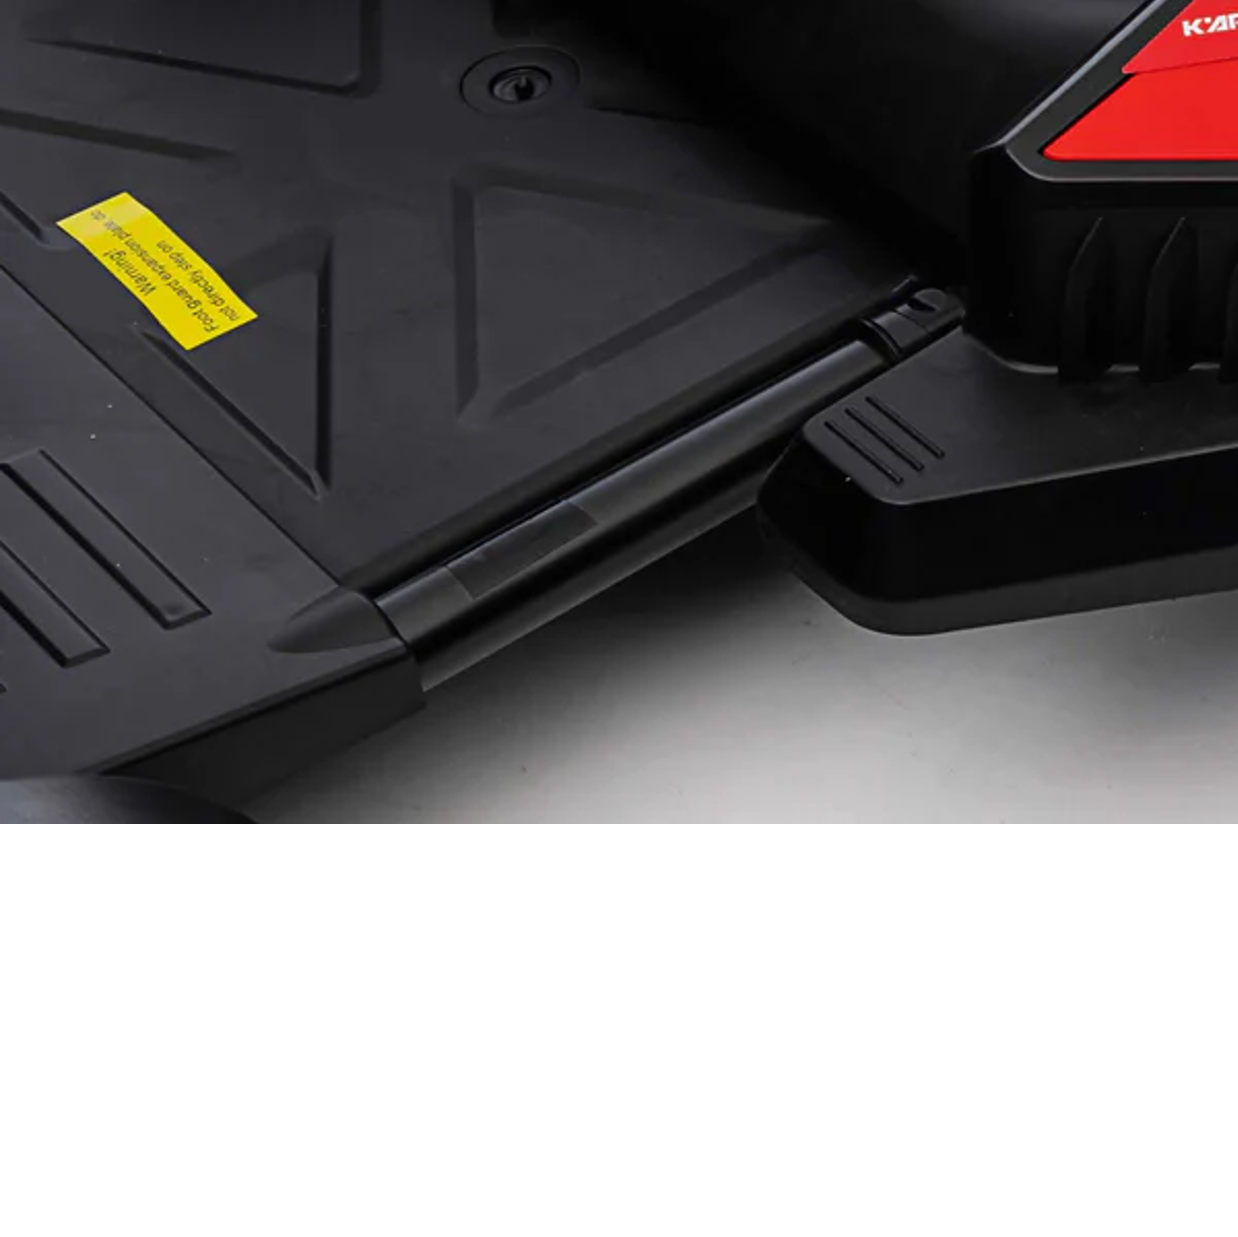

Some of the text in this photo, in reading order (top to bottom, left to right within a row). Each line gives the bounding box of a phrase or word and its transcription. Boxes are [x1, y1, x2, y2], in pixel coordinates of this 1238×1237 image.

[103, 248, 157, 297] Warning!
[124, 239, 172, 282] expansion
[169, 252, 192, 272] step
[166, 282, 203, 311] guard
[191, 270, 226, 308] directly
[192, 311, 221, 333] Foot
